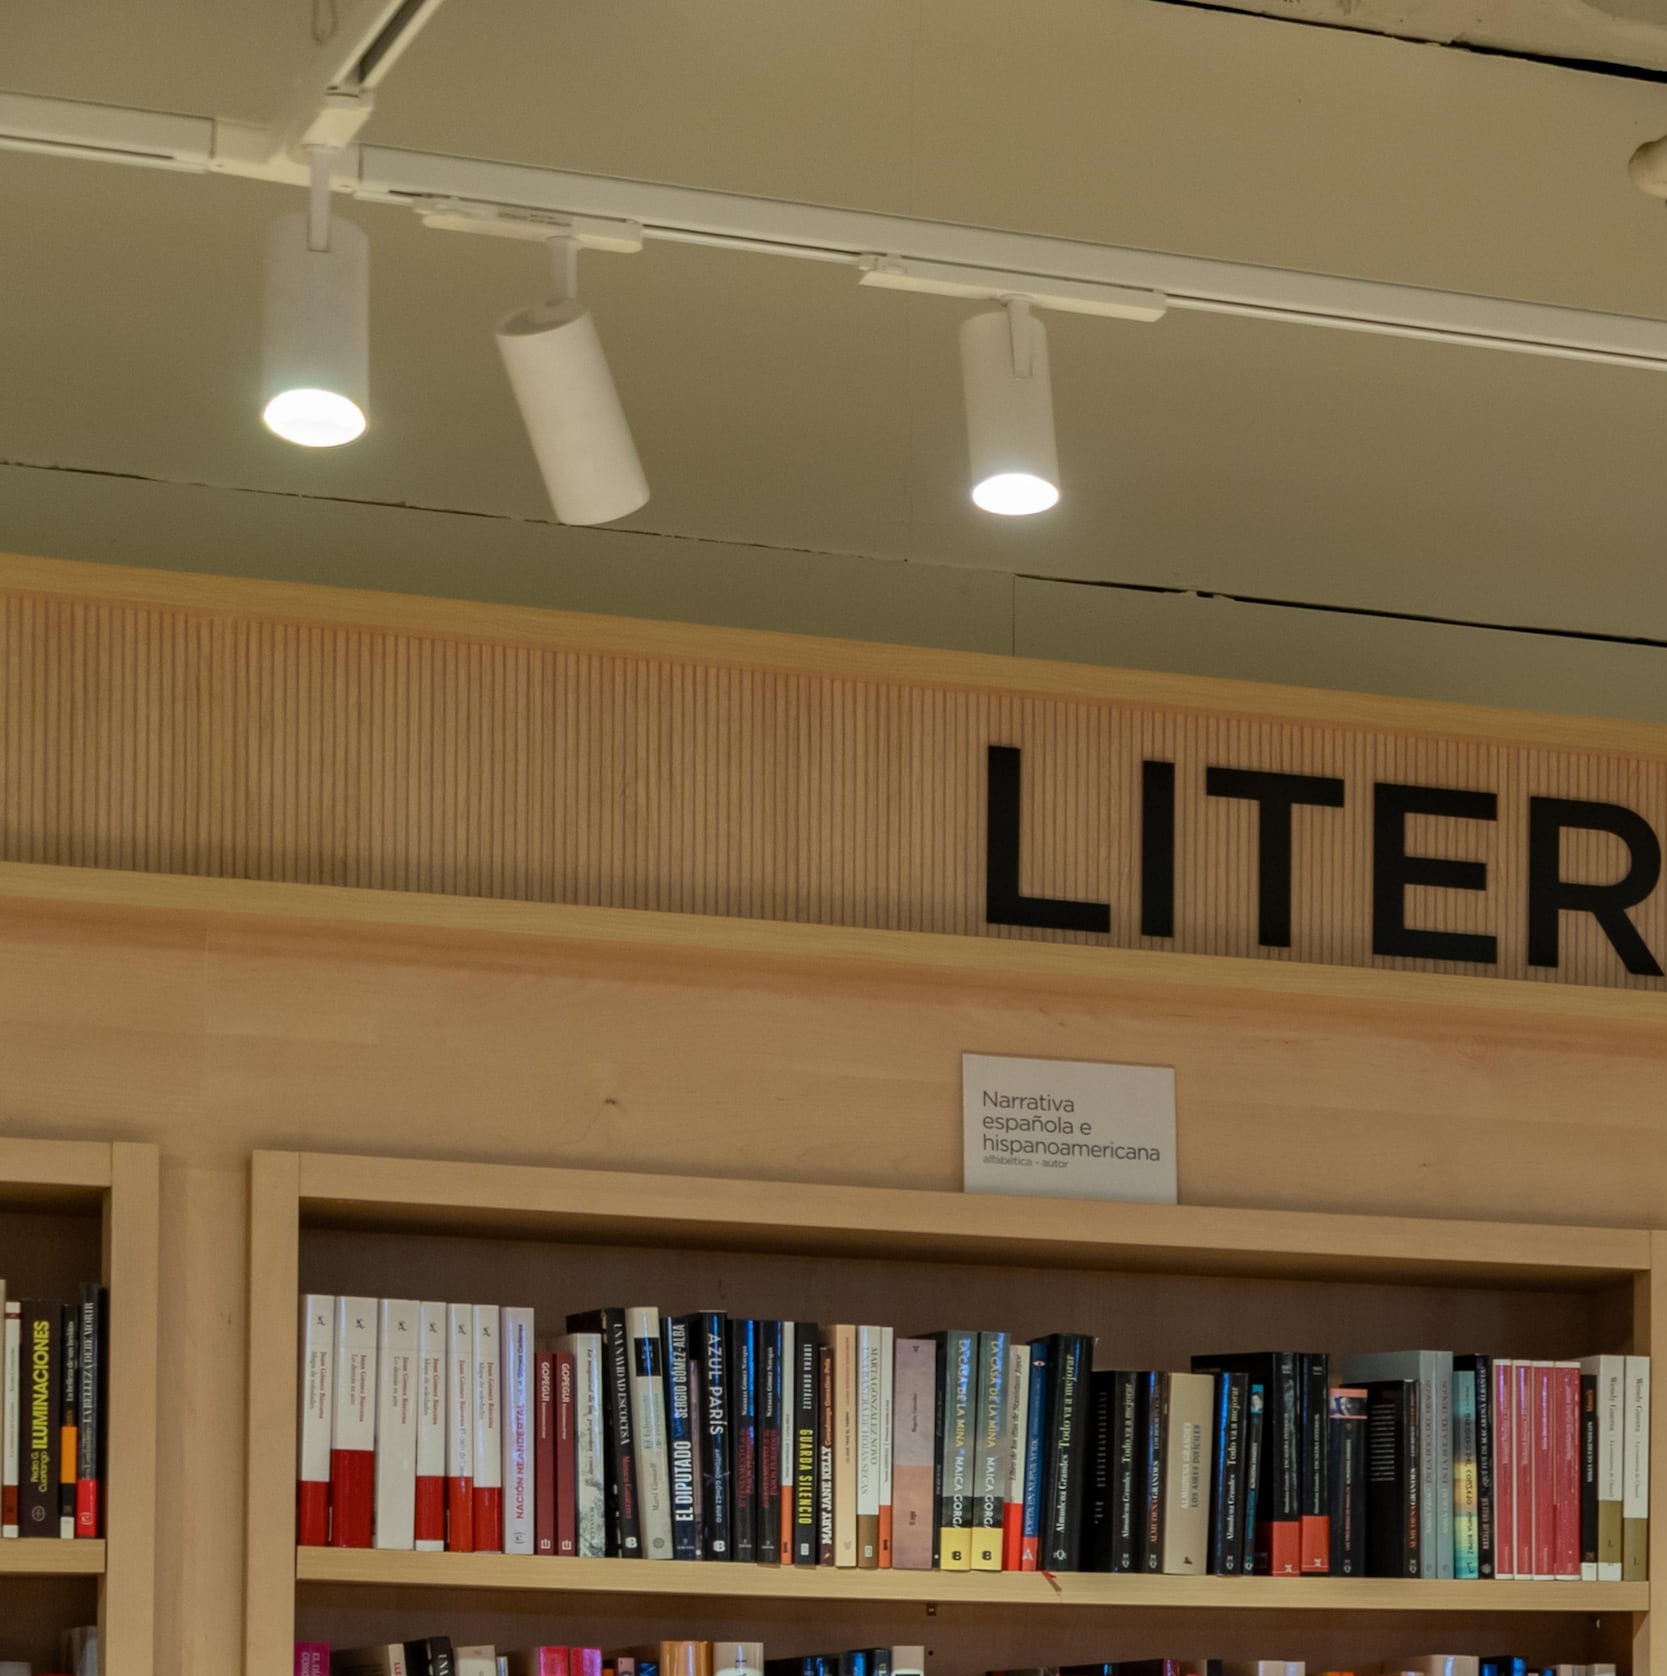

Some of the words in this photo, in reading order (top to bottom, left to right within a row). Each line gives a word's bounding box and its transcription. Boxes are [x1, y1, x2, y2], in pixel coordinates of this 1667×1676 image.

[982, 1090, 1075, 1113] Narrativa
[982, 1115, 1074, 1133] española
[1080, 1122, 1092, 1136] e
[982, 1134, 1161, 1161] hispanoamericana
[982, 1155, 1033, 1167] alfabética
[1042, 1159, 1069, 1168] autor
[673, 1324, 686, 1382] GÓMEZ-ALBA
[708, 1333, 722, 1380] AZUL
[31, 1320, 50, 1450] ILUMINACIONES
[542, 1361, 550, 1402] GOPEGUI
[674, 1386, 688, 1419] SERGIO
[709, 1387, 723, 1435] PARÍS
[800, 1429, 813, 1471] GUARDA
[822, 1446, 832, 1480] KELLY
[675, 1441, 692, 1504] DIPUTADO
[799, 1475, 812, 1524] SILENCIO
[822, 1482, 832, 1511] JANE
[675, 1507, 693, 1521] EL
[821, 1512, 832, 1545] MARY
